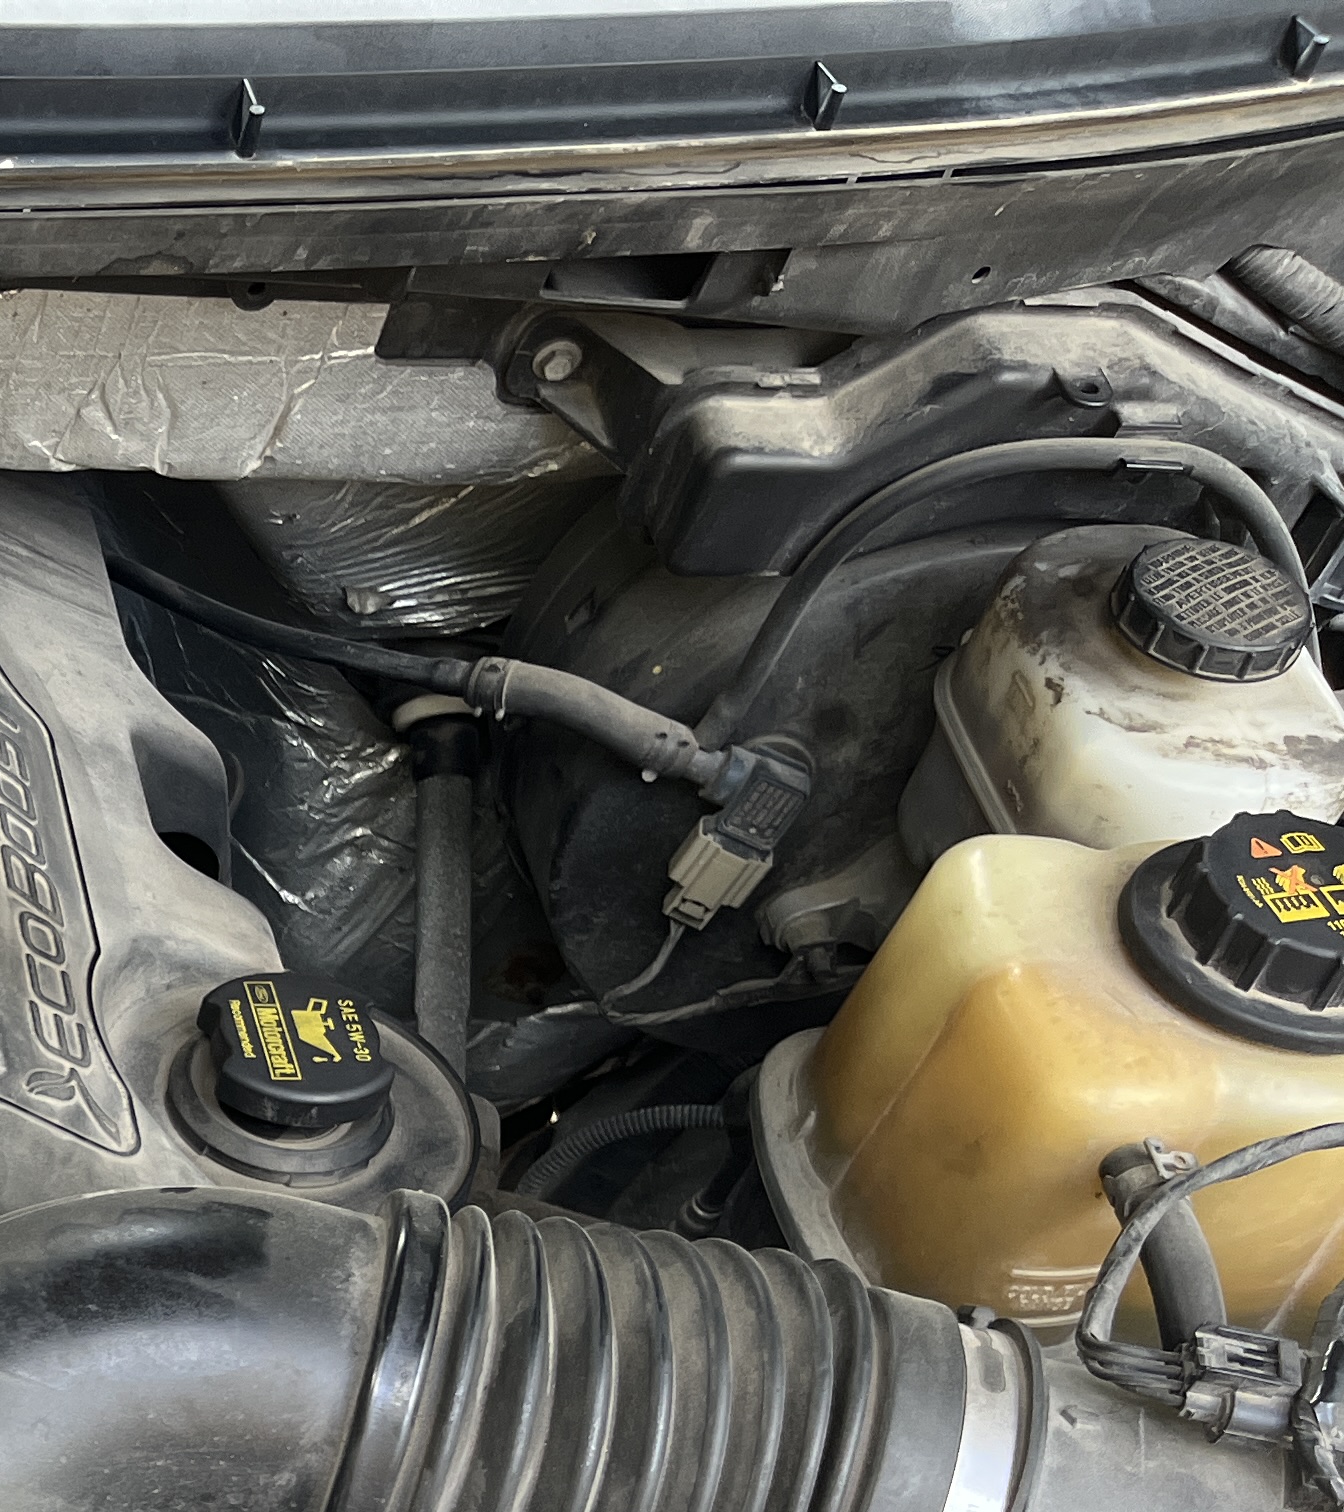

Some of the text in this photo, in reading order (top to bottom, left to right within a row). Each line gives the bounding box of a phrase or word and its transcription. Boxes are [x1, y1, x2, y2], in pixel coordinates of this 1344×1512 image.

[228, 999, 257, 1059] Recommended
[256, 1007, 297, 1078] Motorcraft
[337, 999, 372, 1062] SAE 5W-30
